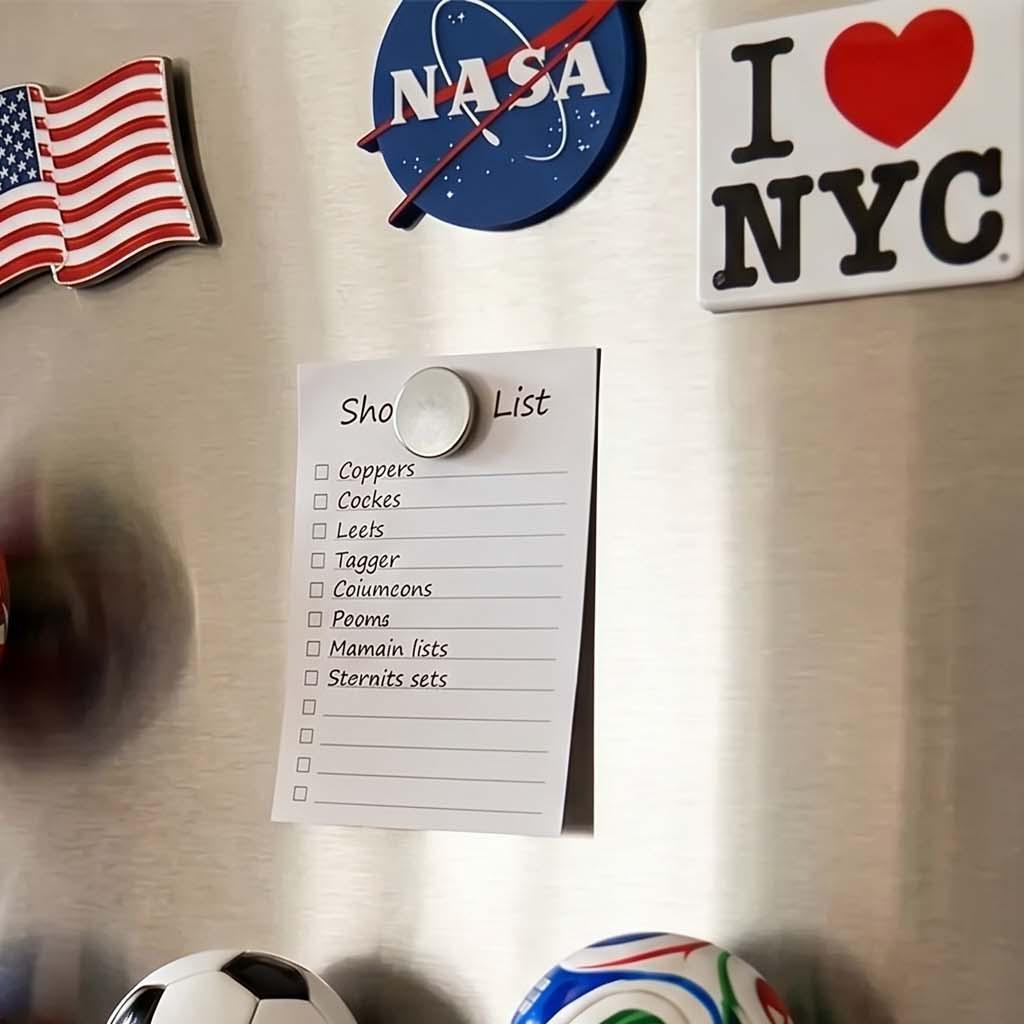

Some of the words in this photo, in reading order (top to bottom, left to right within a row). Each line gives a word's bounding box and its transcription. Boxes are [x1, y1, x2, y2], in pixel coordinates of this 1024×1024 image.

[390, 40, 610, 126] NASA
[731, 37, 795, 164] I
[712, 148, 1004, 290] NYC
[493, 386, 551, 418] List
[338, 461, 416, 485] Coppers
[337, 489, 402, 509] Cockes
[336, 520, 385, 539] Leets
[335, 551, 401, 574] Tagger
[332, 610, 390, 628] Pooms
[329, 638, 404, 657] Mamain
[412, 638, 449, 658] lists
[327, 669, 404, 688] Sternits
[410, 672, 448, 688] sets
